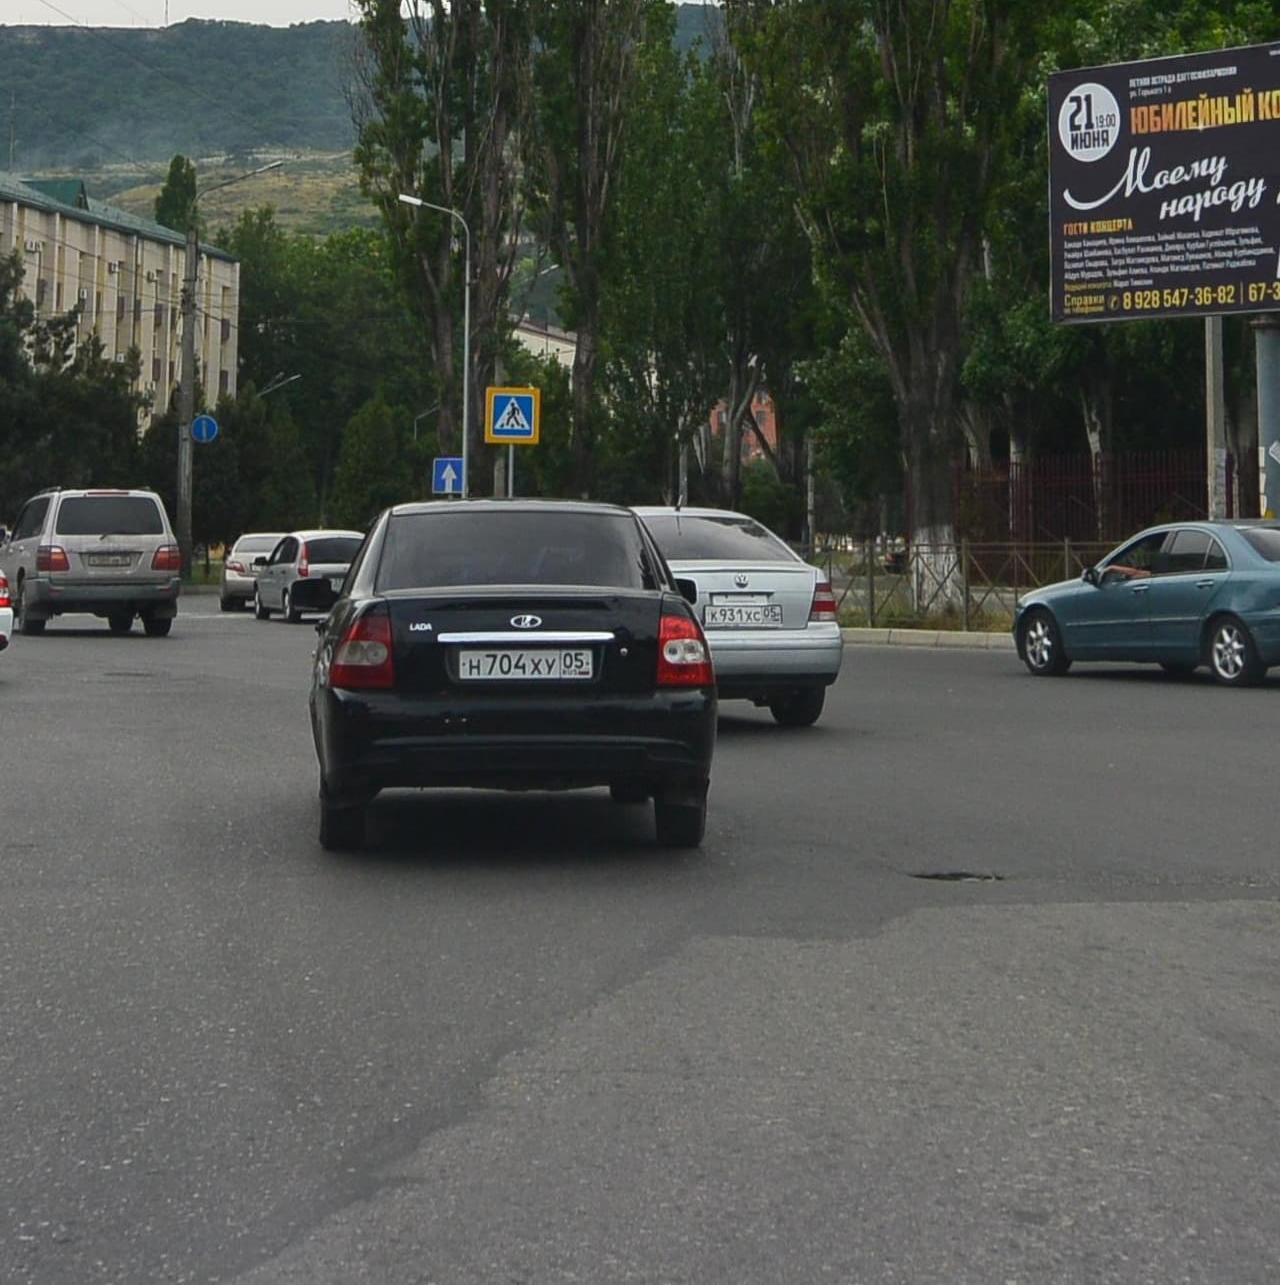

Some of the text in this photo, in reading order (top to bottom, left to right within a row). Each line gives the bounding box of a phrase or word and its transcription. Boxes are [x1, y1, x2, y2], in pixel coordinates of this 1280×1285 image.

[1069, 93, 1094, 131] 21
[1095, 114, 1116, 129] 19:00
[1131, 87, 1254, 135] ЮБИЛЕЙНЫЙ
[1071, 130, 1109, 151] ИЮНЯ
[1063, 146, 1228, 210] Моему
[1159, 178, 1267, 222] народу
[1063, 217, 1134, 236] ГОСТИ КОНЦЕРТА
[1122, 293, 1132, 310] 8
[1134, 290, 1160, 310] 928
[1163, 285, 1235, 307] 547-36-82
[763, 607, 777, 619] 05
[409, 622, 433, 632] LADA
[562, 652, 585, 670] 05
